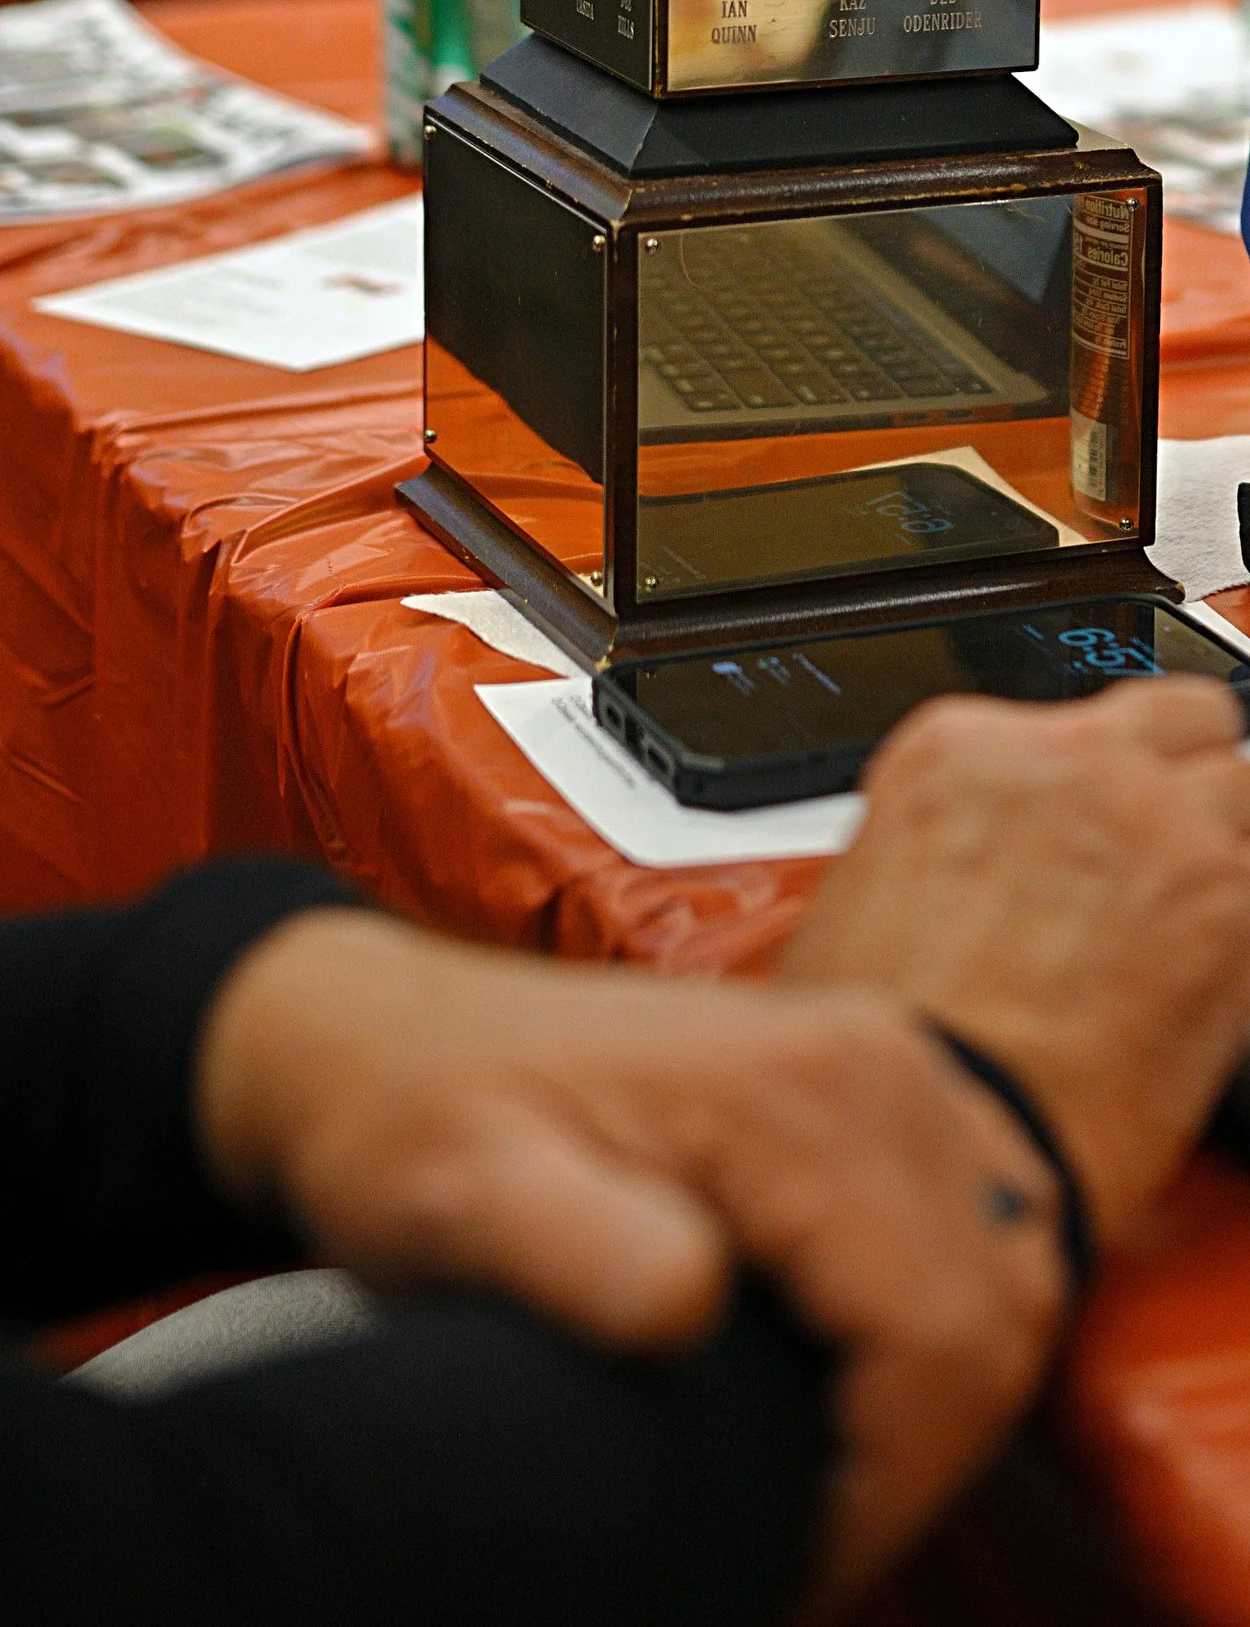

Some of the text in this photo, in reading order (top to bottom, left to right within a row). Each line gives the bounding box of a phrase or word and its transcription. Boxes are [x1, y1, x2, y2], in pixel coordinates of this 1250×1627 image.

[721, 0, 748, 19] IAN
[828, 17, 876, 39] SENJU
[903, 11, 983, 33] ODENRIDER
[710, 24, 758, 45] QUINN
